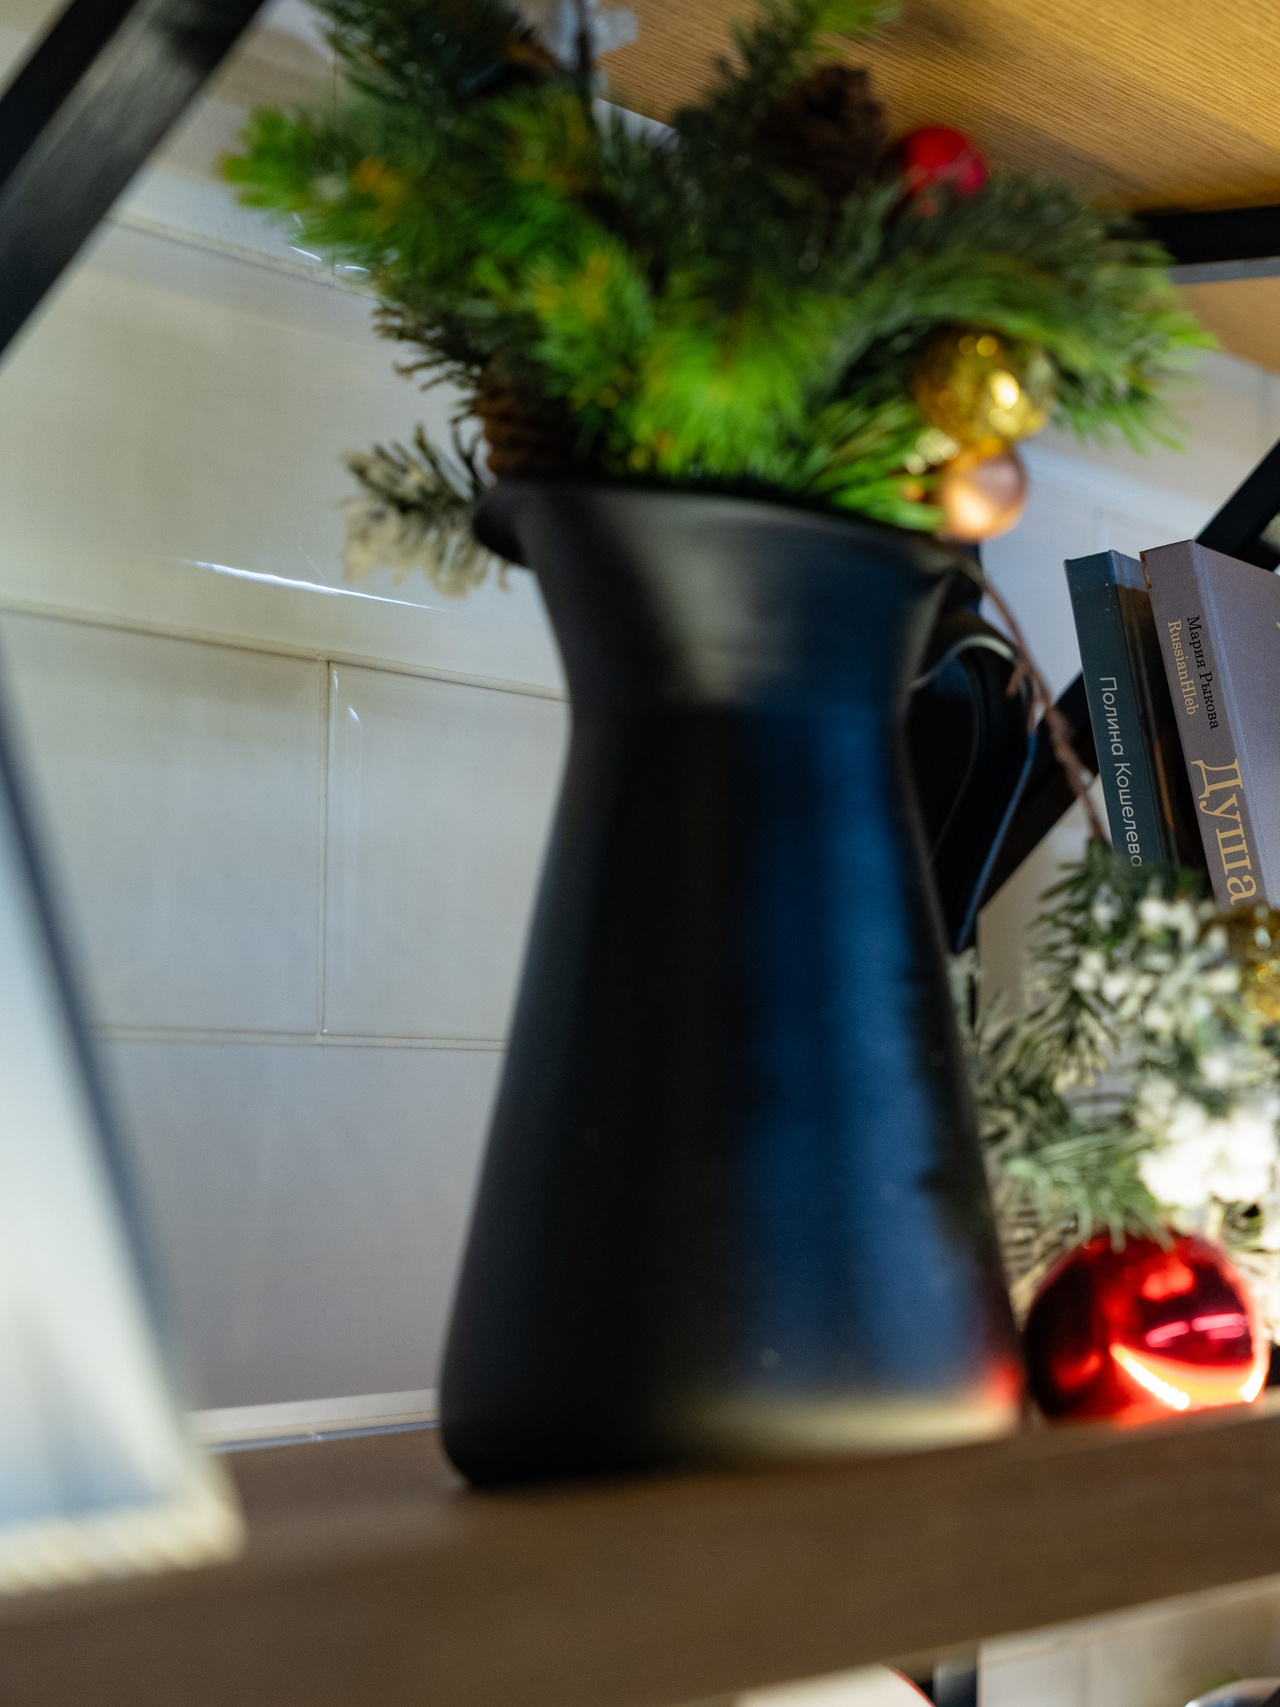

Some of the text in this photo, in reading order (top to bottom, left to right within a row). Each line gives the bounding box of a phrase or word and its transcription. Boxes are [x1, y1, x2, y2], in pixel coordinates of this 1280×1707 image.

[1167, 619, 1197, 716] RussianHleb
[1187, 614, 1219, 730] Мария Рыкова
[1098, 675, 1143, 869] Полина Кошелева
[1190, 757, 1257, 906] Душа
